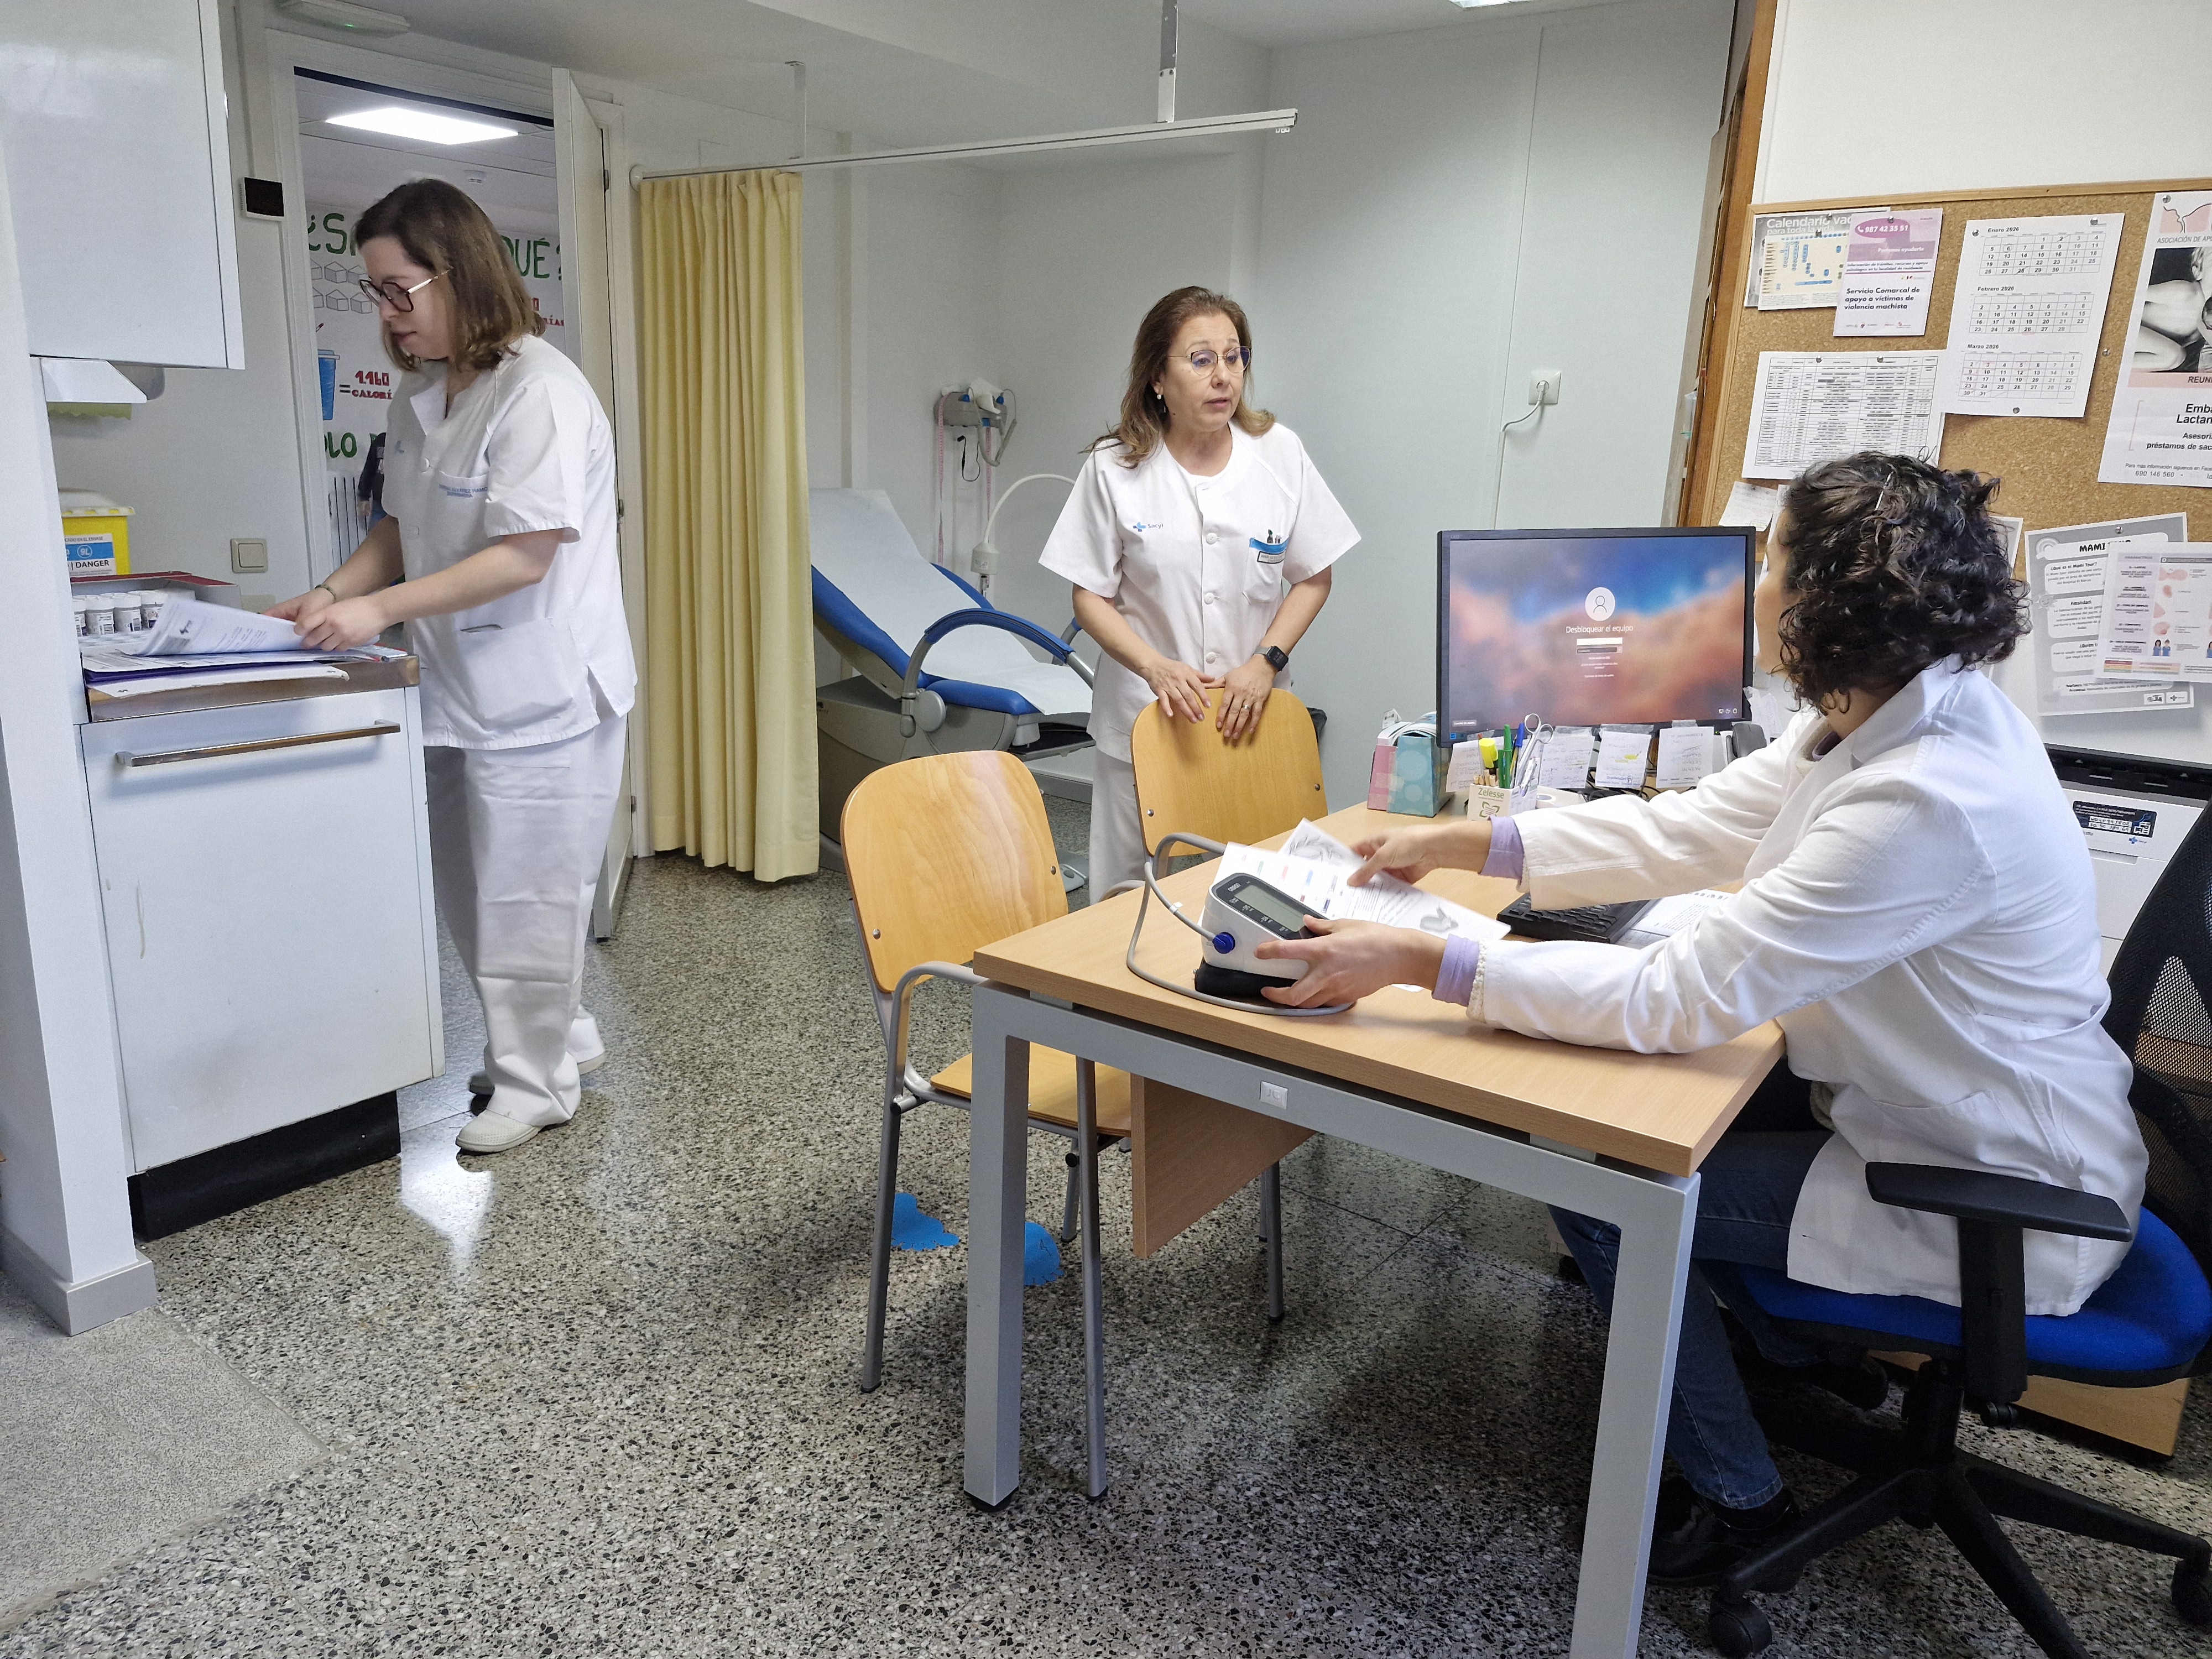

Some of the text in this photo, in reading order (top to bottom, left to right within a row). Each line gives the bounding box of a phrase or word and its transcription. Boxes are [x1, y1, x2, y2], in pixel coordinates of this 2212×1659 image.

[1767, 216, 1831, 228] Calendario
[2079, 542, 2106, 552] MAMI
[75, 560, 109, 568] DANGER
[1566, 625, 1604, 634] Desbloquear
[1612, 624, 1634, 633] equipo
[1478, 787, 1504, 799] Zelesse
